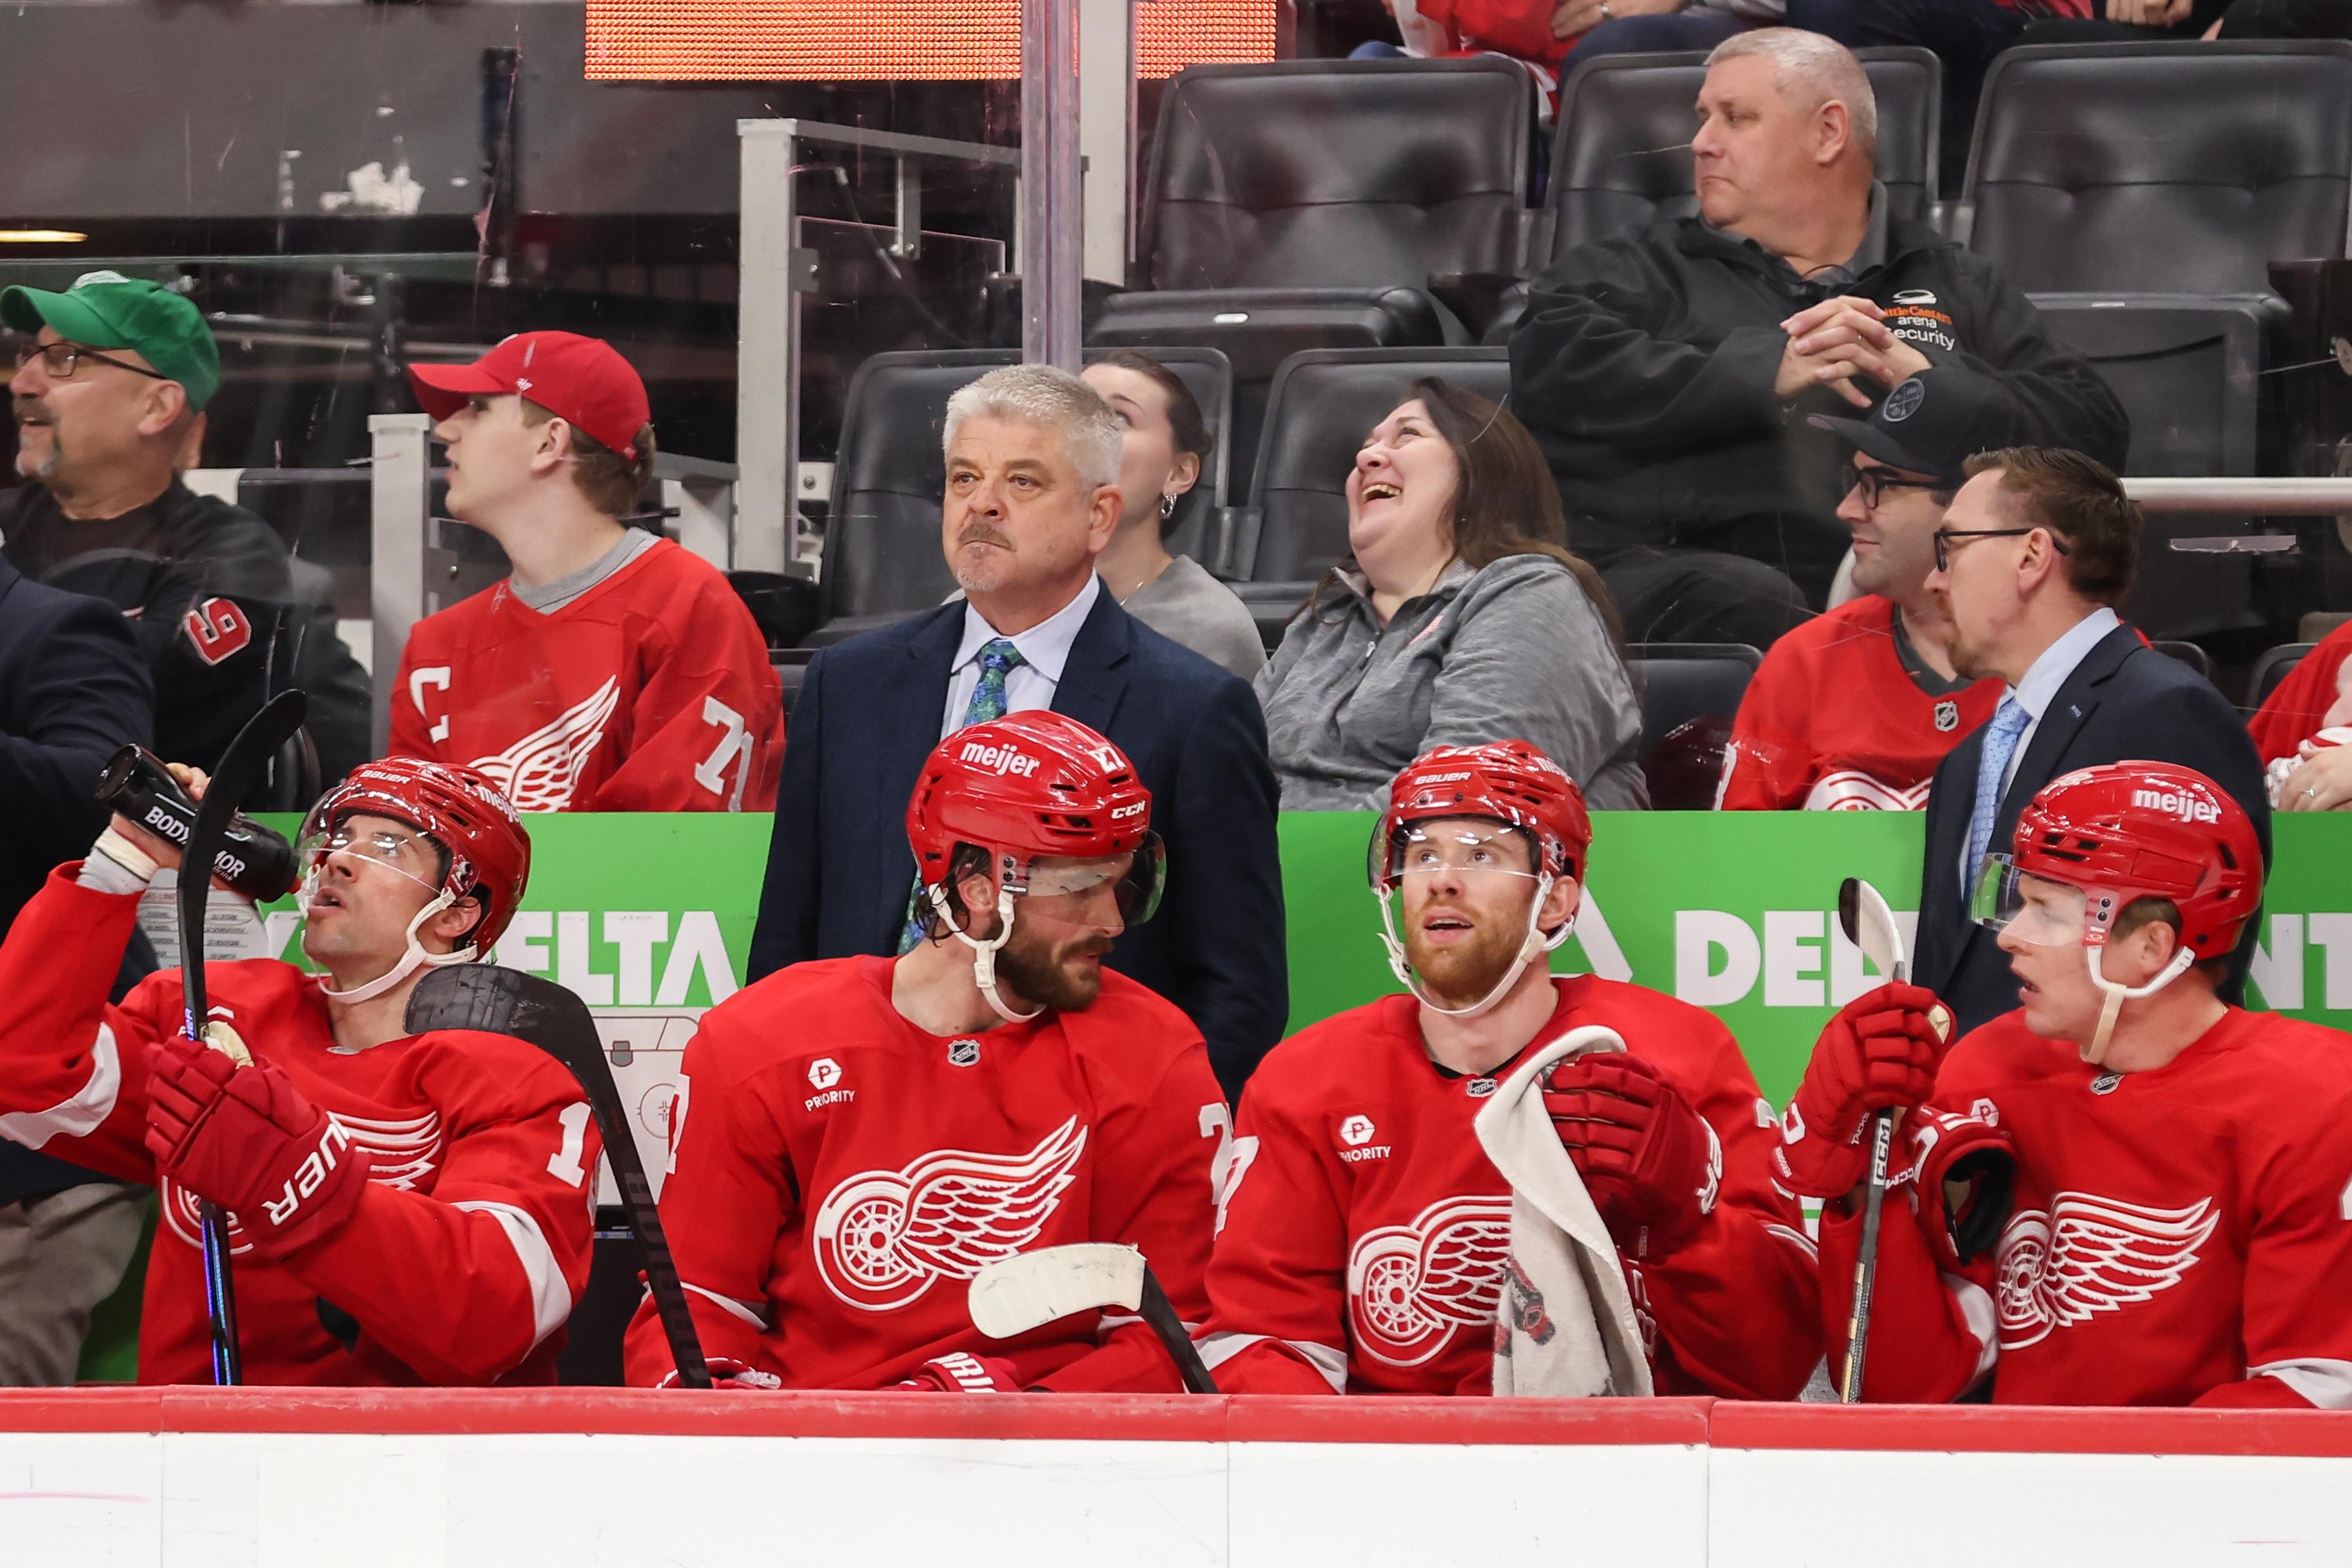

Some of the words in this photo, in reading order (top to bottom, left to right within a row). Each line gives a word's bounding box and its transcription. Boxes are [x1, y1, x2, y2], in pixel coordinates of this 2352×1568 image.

[1897, 316, 1937, 328] arena
[409, 667, 451, 743] C
[961, 742, 1041, 778] meijer
[360, 770, 411, 785] BAUER
[1414, 772, 1472, 785] BAUER
[1111, 800, 1146, 820] CCM
[2133, 789, 2220, 825] meijer
[484, 910, 740, 1006] ELTA
[1675, 910, 1920, 1007] DEL
[805, 1090, 856, 1112] PRIORITY
[1876, 1122, 1891, 1181] CCM
[1885, 1167, 1915, 1191] CCM
